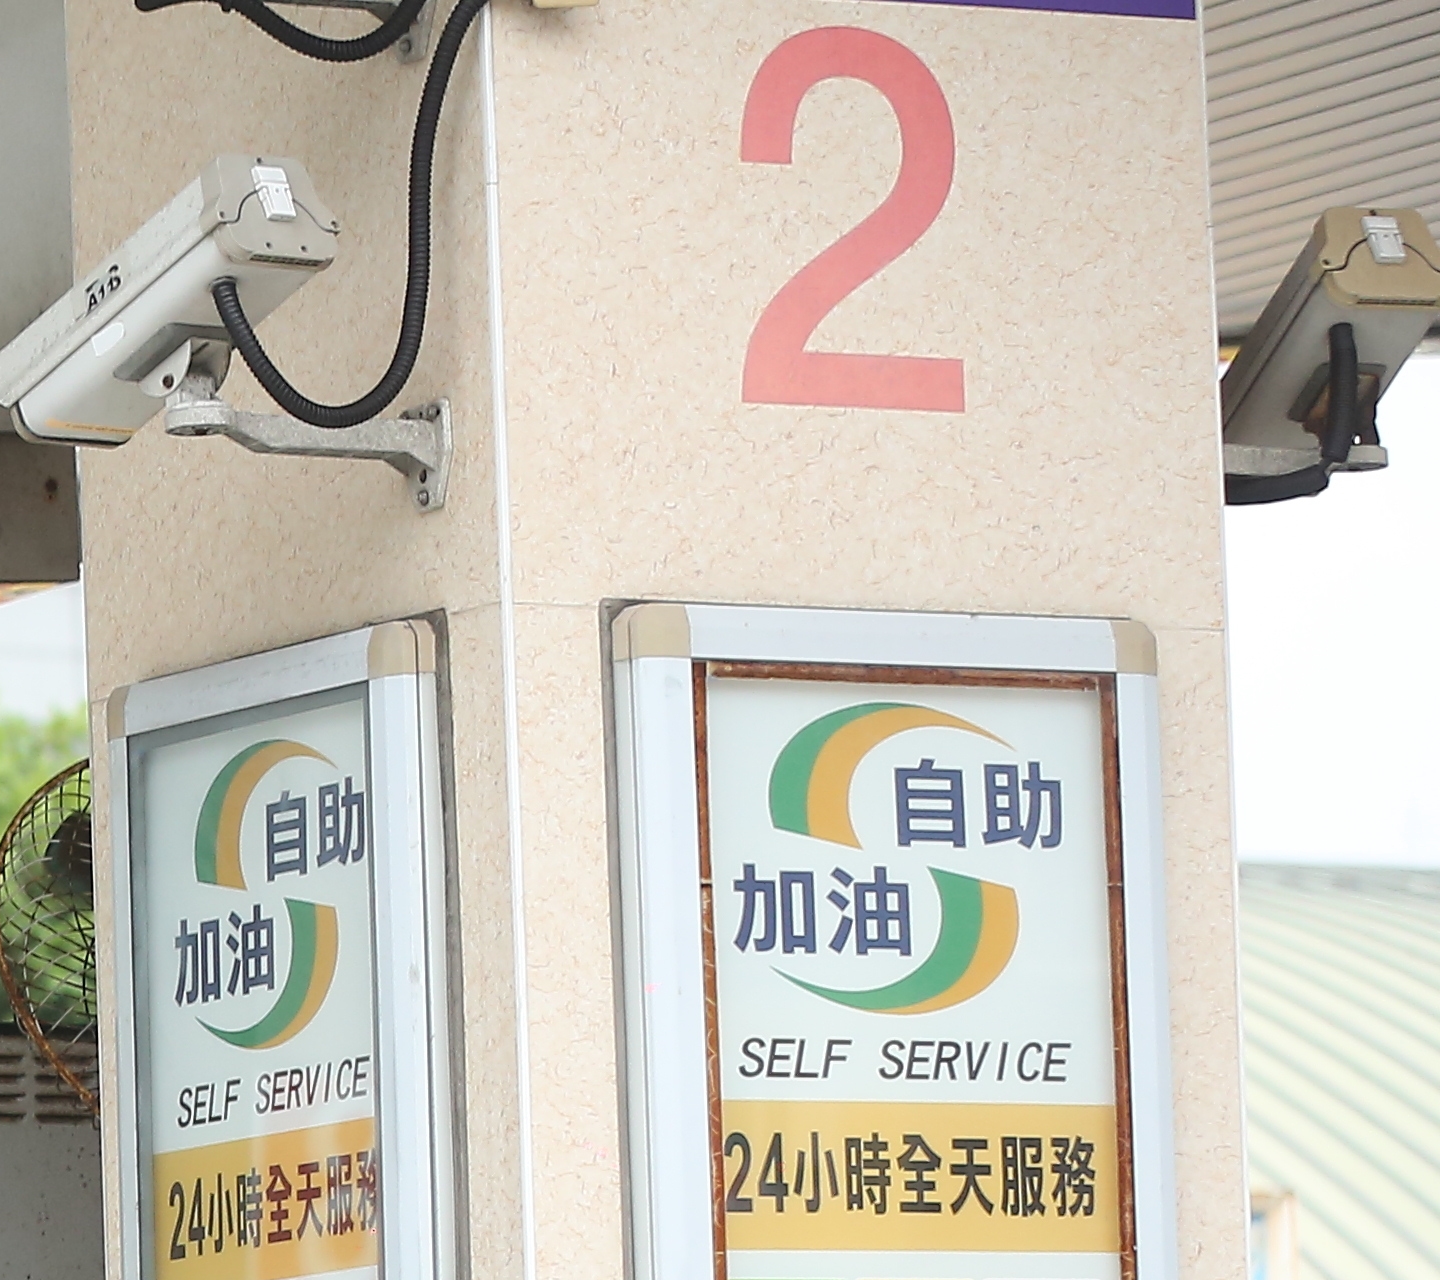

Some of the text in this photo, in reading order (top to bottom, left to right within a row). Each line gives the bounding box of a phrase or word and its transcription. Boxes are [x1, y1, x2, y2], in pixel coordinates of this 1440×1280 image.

[740, 26, 966, 413] 2
[265, 775, 366, 882] 自助
[893, 759, 1063, 850] 自助
[174, 903, 275, 1007] 加油
[733, 863, 912, 957] 加油
[177, 1054, 370, 1127] SELF SERVICE
[738, 1037, 1072, 1082] SELF SERVICE
[725, 1130, 1096, 1218] 24小時全天服務
